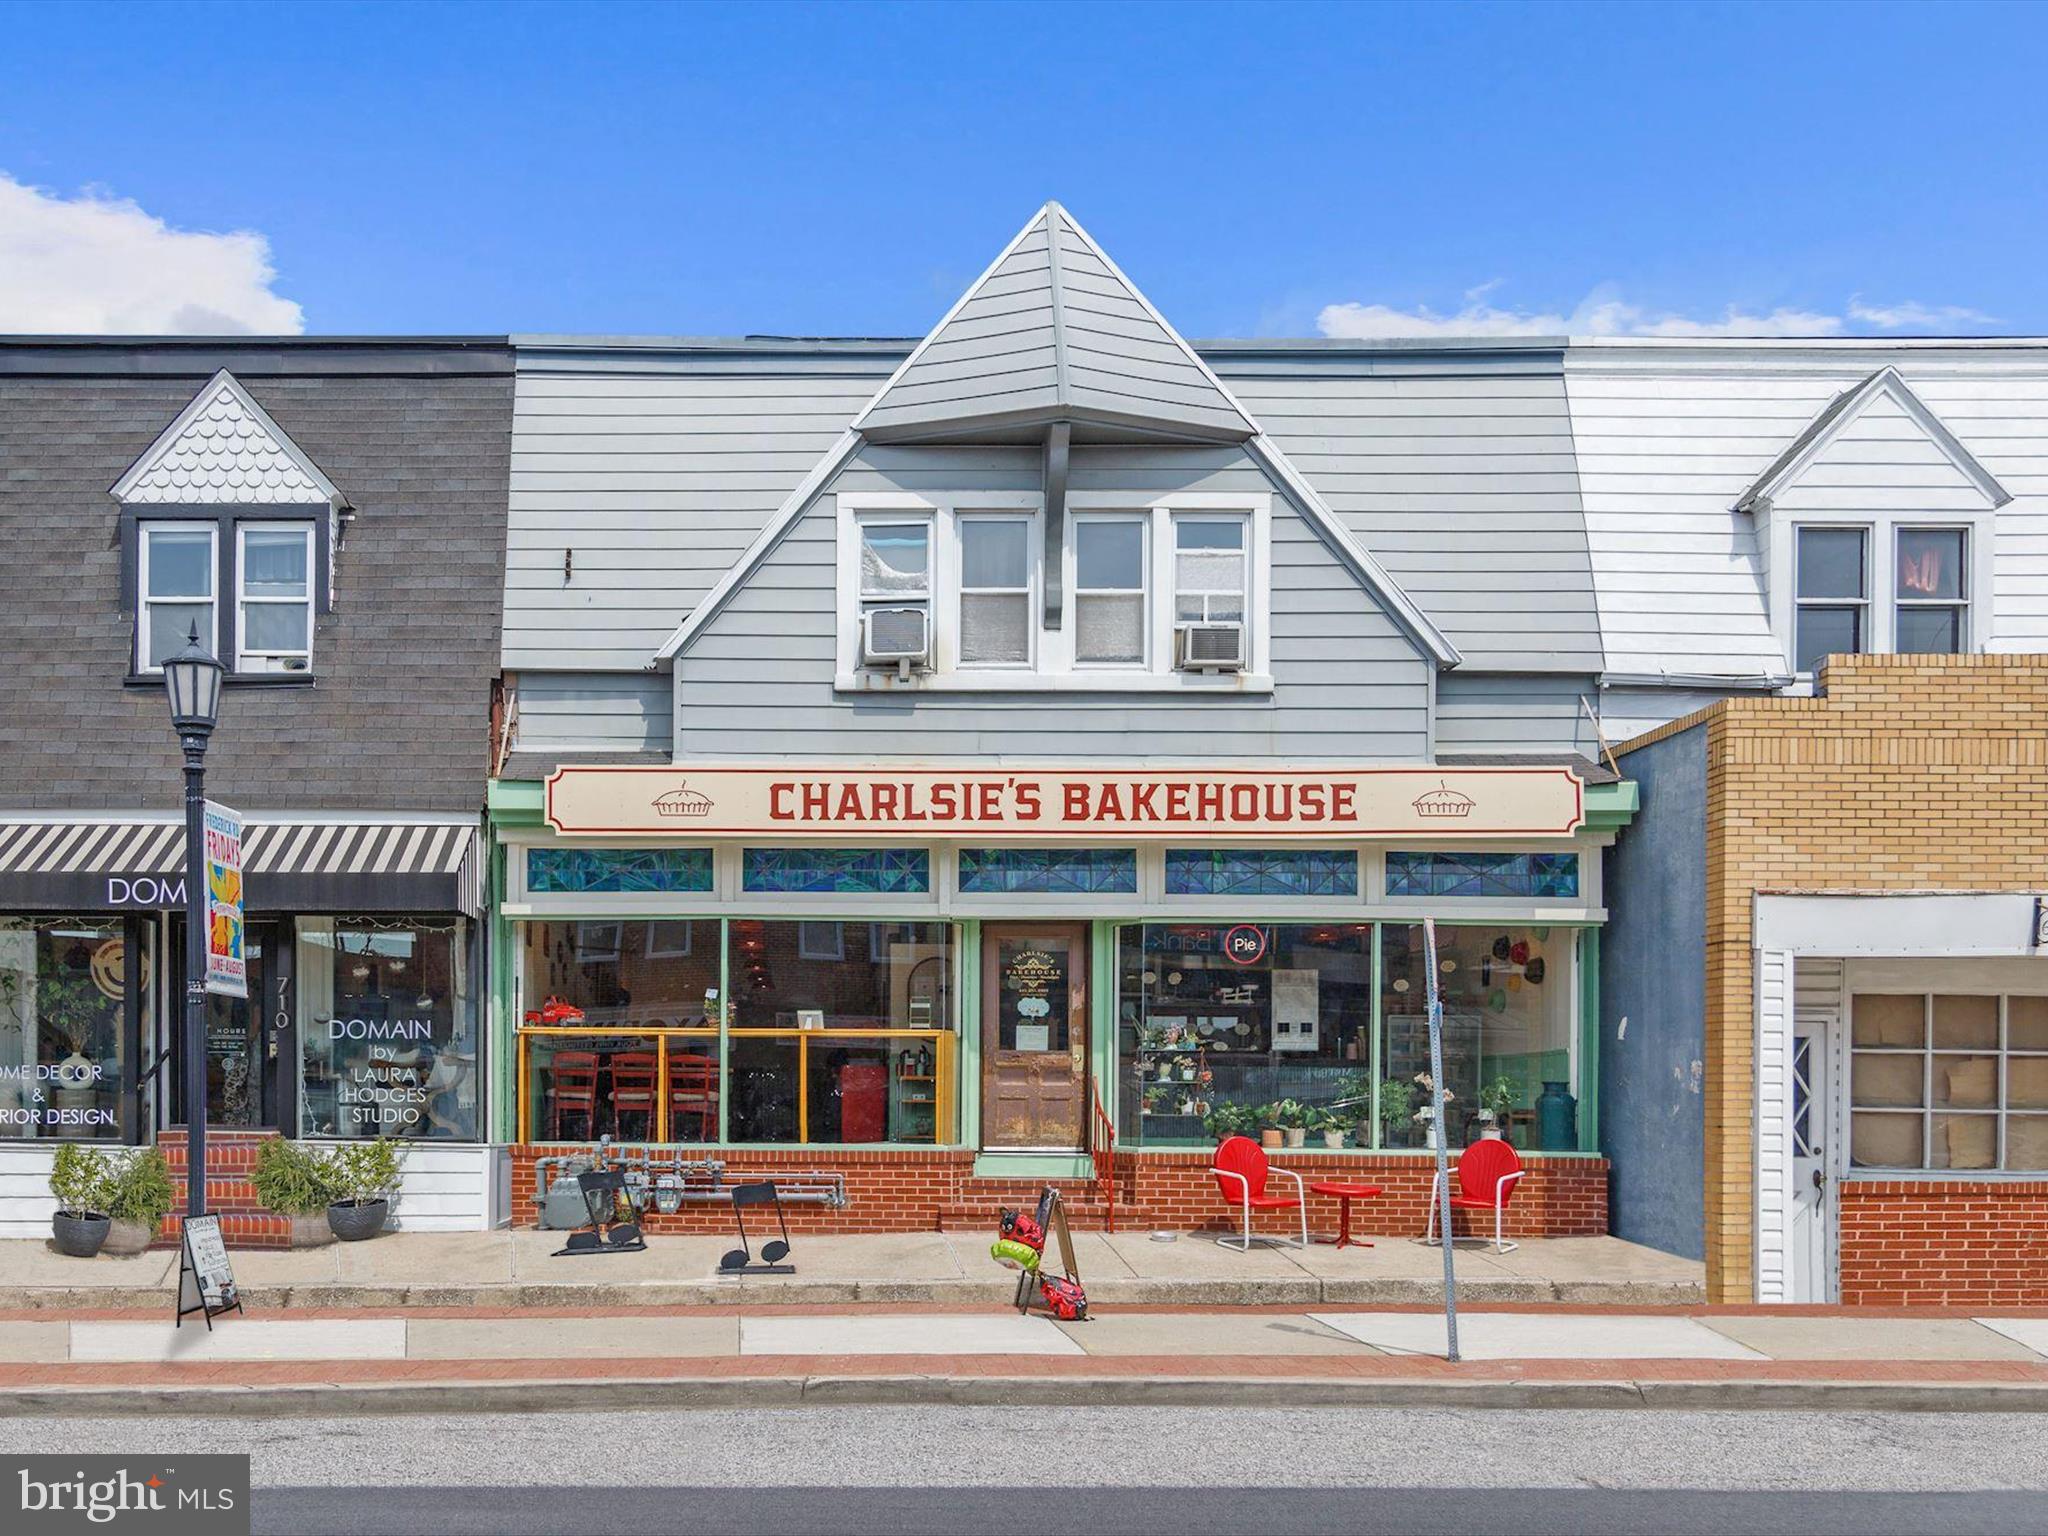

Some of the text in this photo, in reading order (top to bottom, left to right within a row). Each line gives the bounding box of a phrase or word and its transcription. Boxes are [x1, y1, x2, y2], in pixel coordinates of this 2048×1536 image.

[769, 778, 1358, 822] CHARLSIE'S BAKEHOUSE
[207, 830, 241, 868] FRIDAYS
[1234, 938, 1257, 952] Pie
[275, 976, 289, 1029] 710
[329, 1019, 431, 1039] DOMAIN
[374, 1044, 397, 1062] by
[0, 1064, 102, 1081] ME DECOR
[354, 1067, 417, 1082] LAURA
[32, 1087, 45, 1103] &
[345, 1087, 426, 1103] HODGES
[47, 1108, 114, 1125] DESIGN
[352, 1107, 420, 1124] STUDIO
